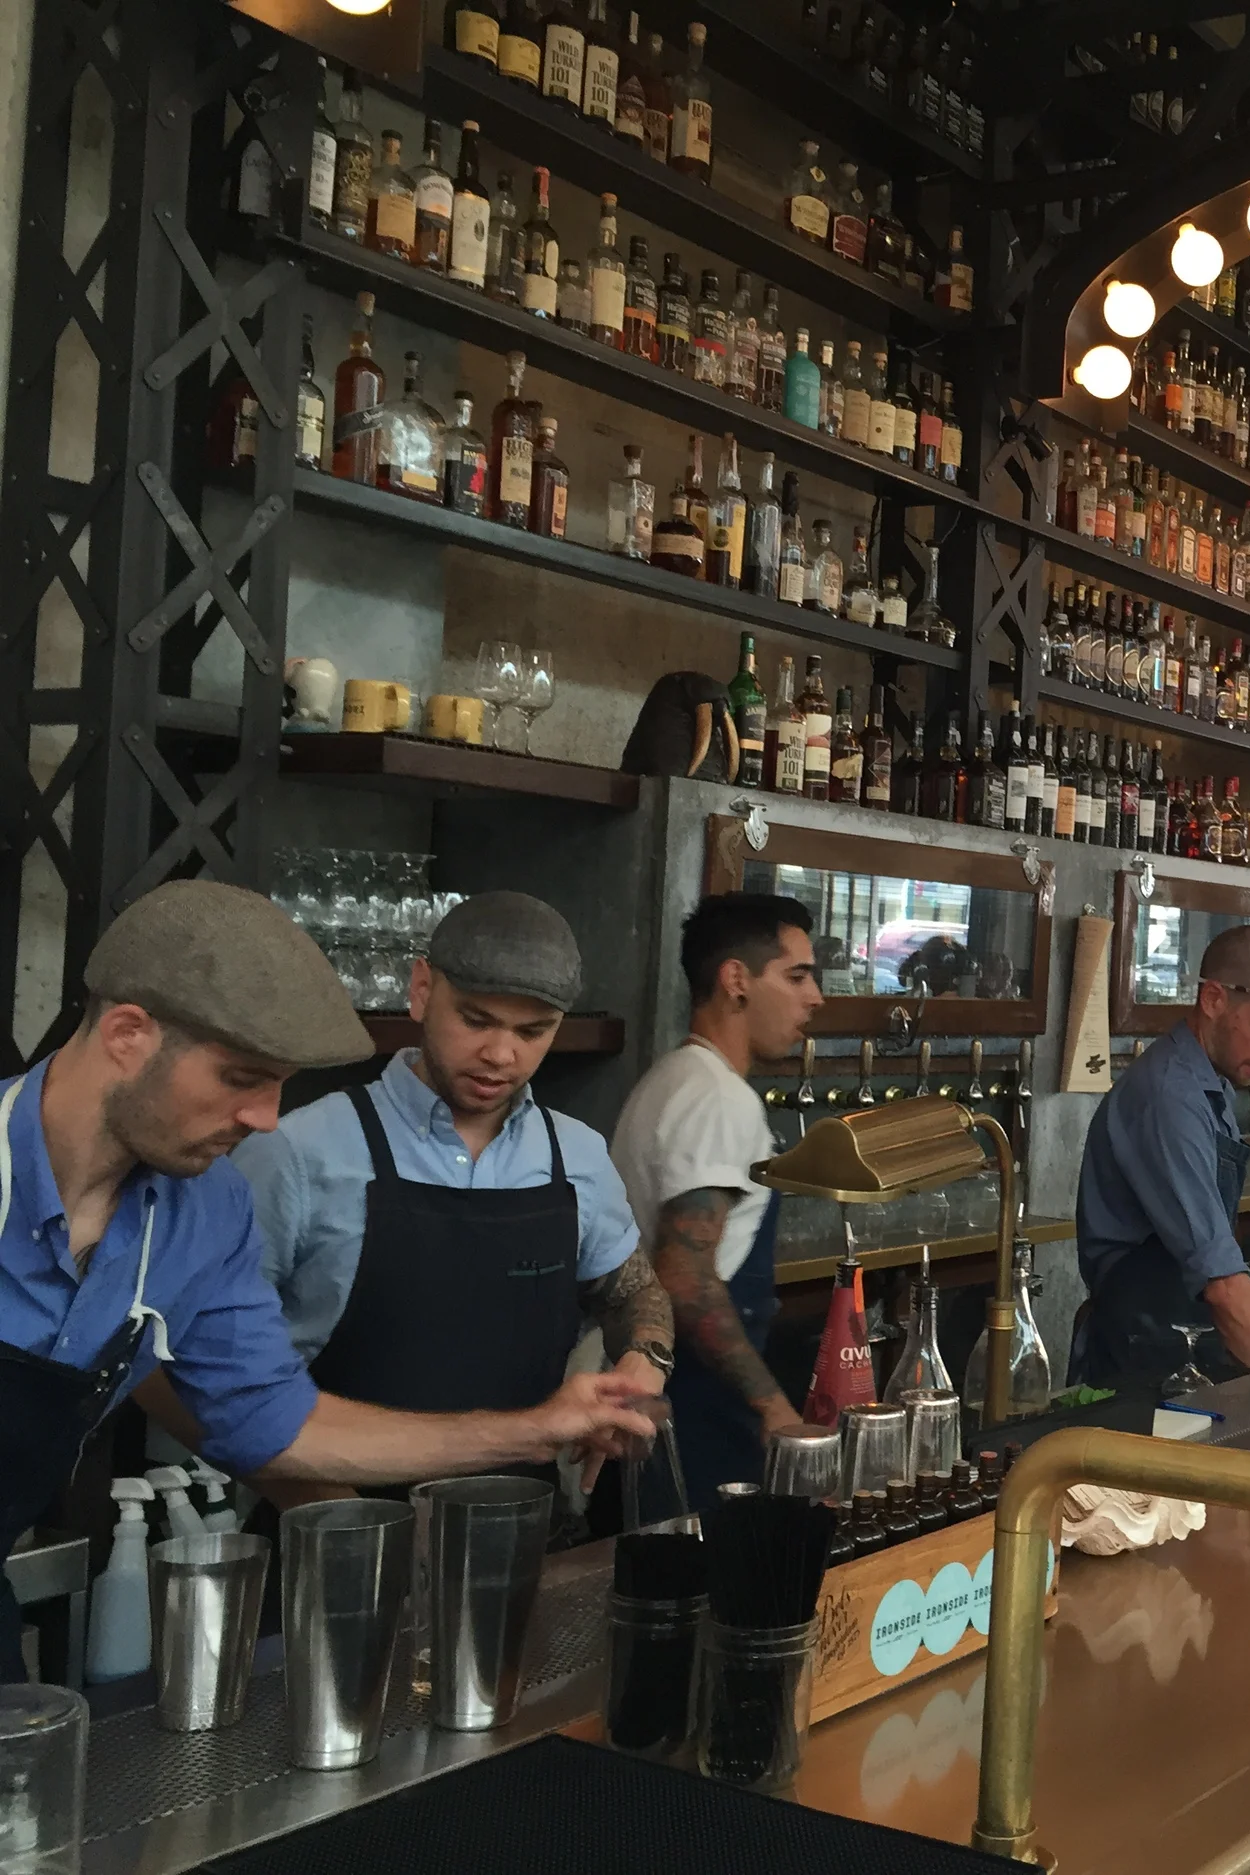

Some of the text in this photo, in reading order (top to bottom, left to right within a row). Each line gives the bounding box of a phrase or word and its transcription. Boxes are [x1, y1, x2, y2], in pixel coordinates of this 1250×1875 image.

[551, 66, 570, 85] 101
[592, 87, 609, 106] 101
[783, 760, 799, 775] 101
[974, 1585, 991, 1600] IRO
[926, 1594, 968, 1619] IRONSIDE
[876, 1612, 921, 1640] IRONSIDE
